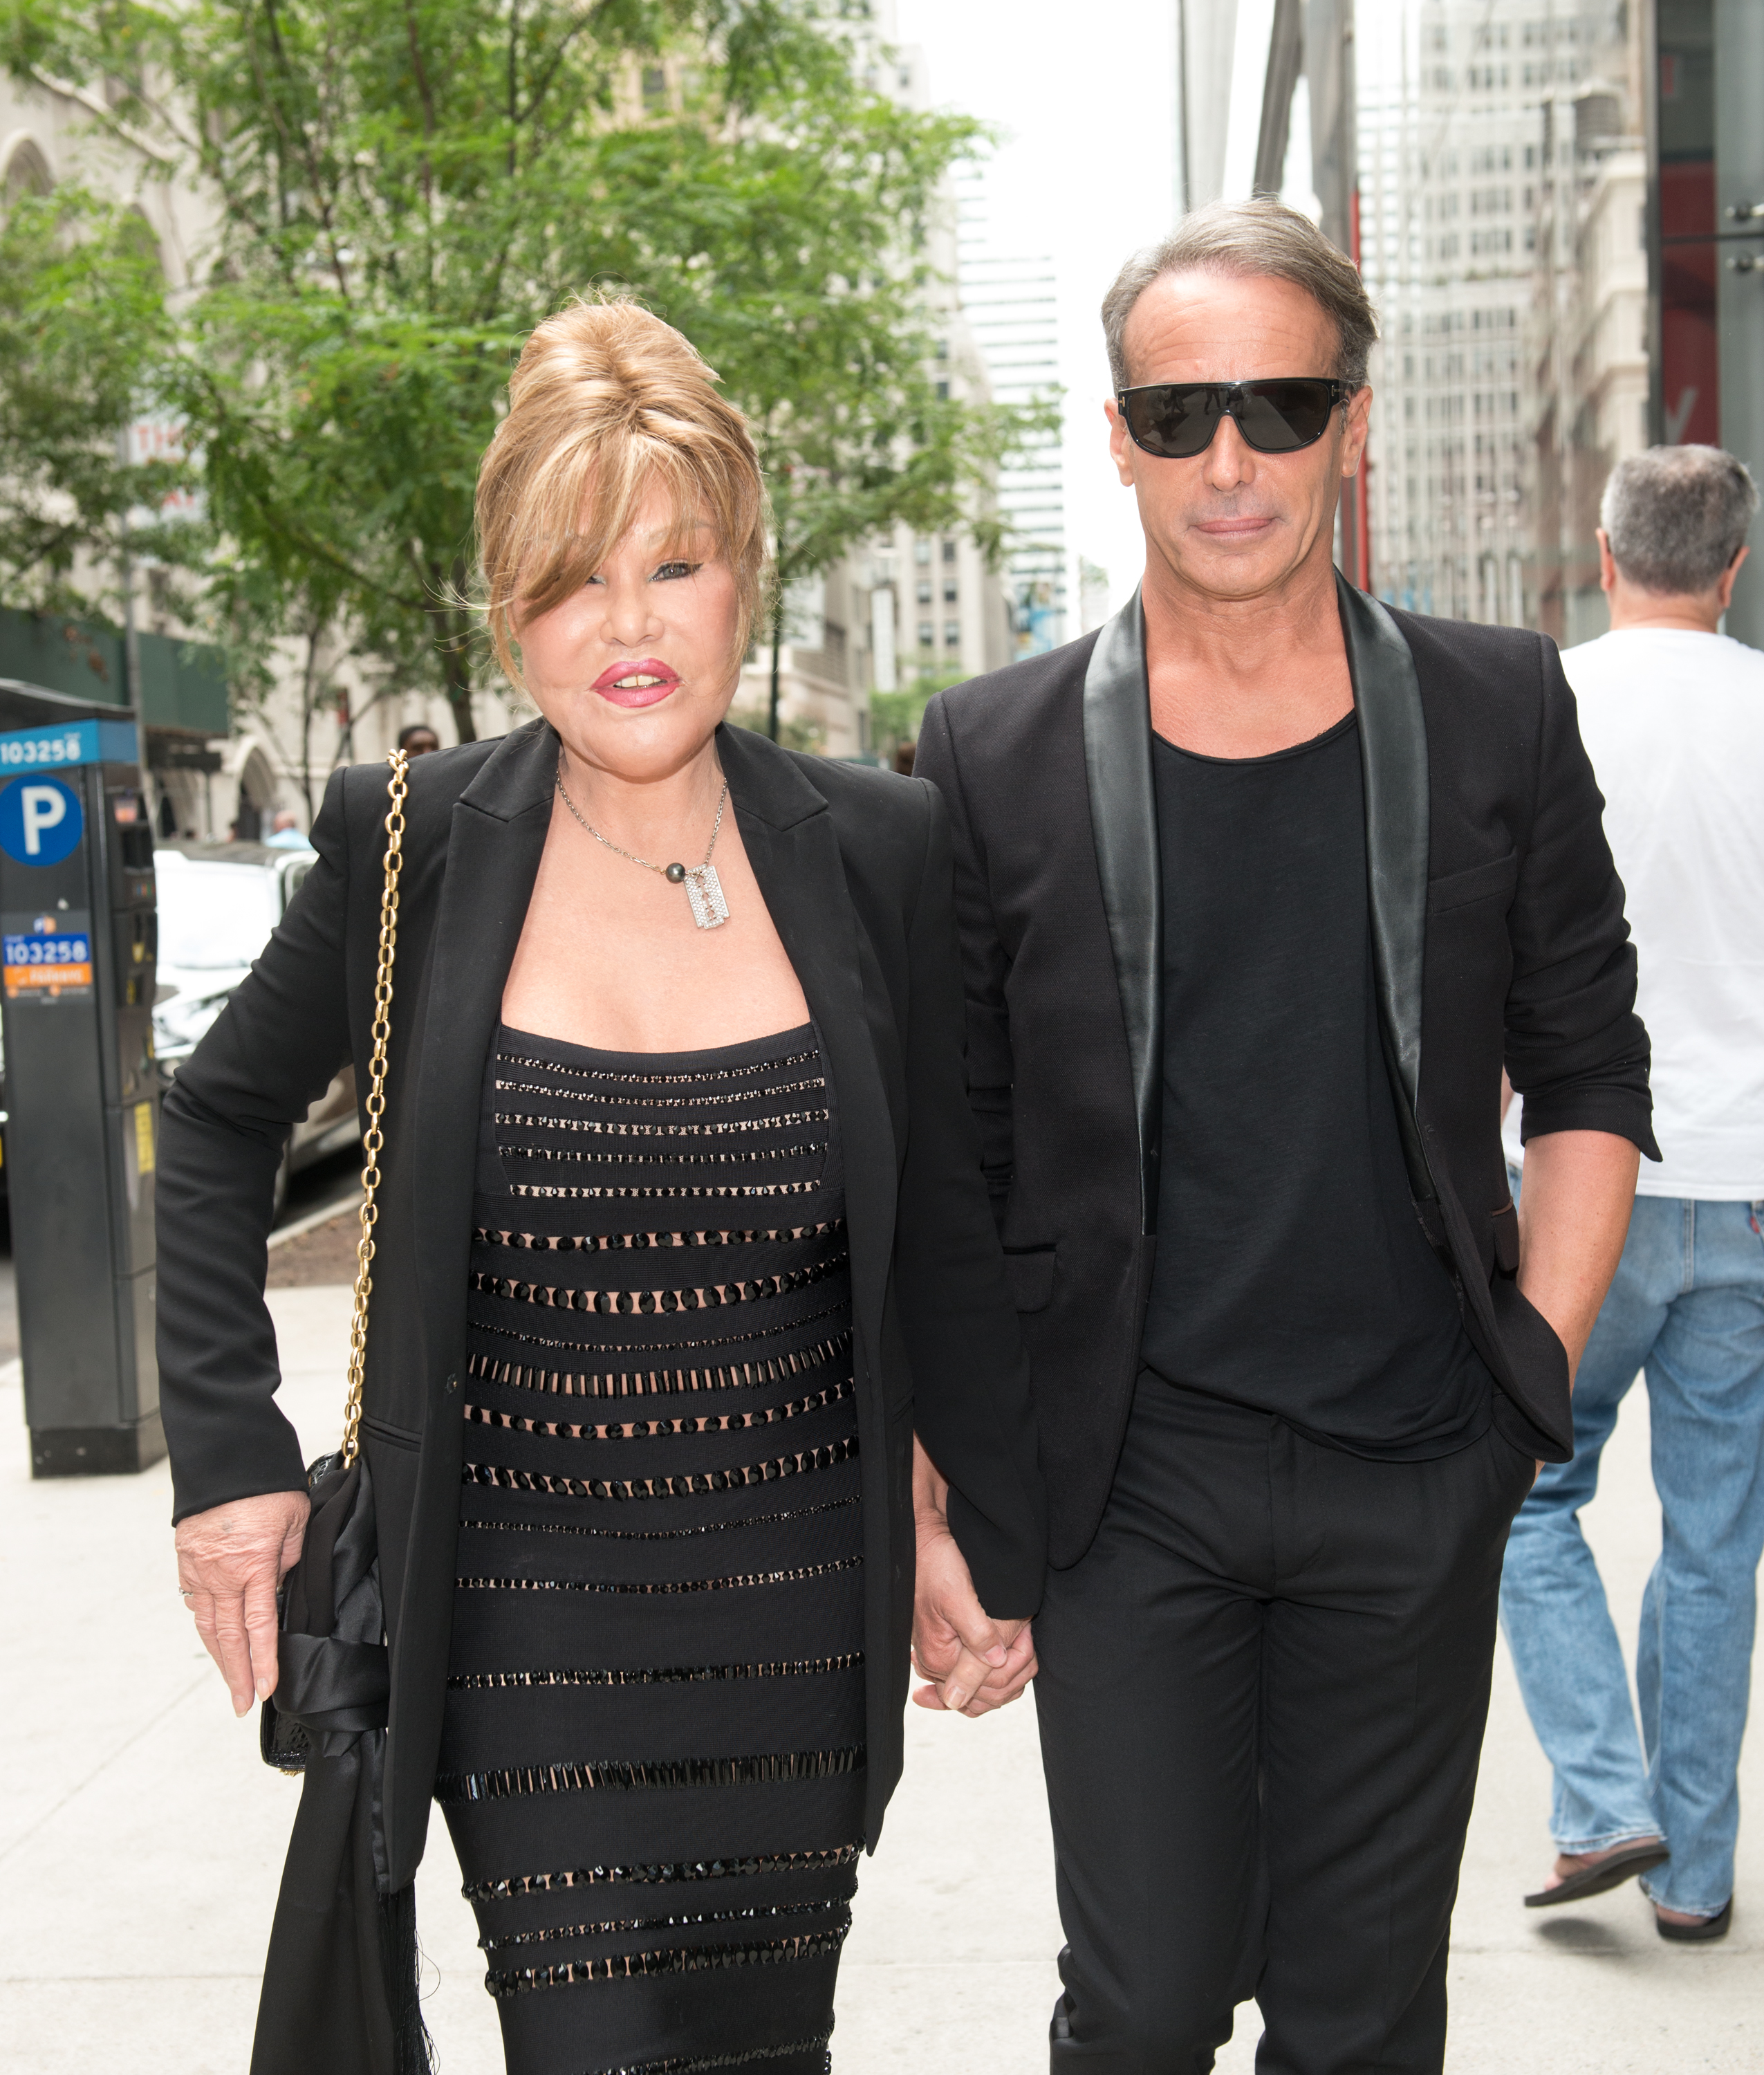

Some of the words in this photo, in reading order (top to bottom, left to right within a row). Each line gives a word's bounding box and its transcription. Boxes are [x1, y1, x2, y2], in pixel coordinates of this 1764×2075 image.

[0, 739, 81, 765] 103258
[21, 785, 66, 855] P
[6, 941, 86, 965] 103258
